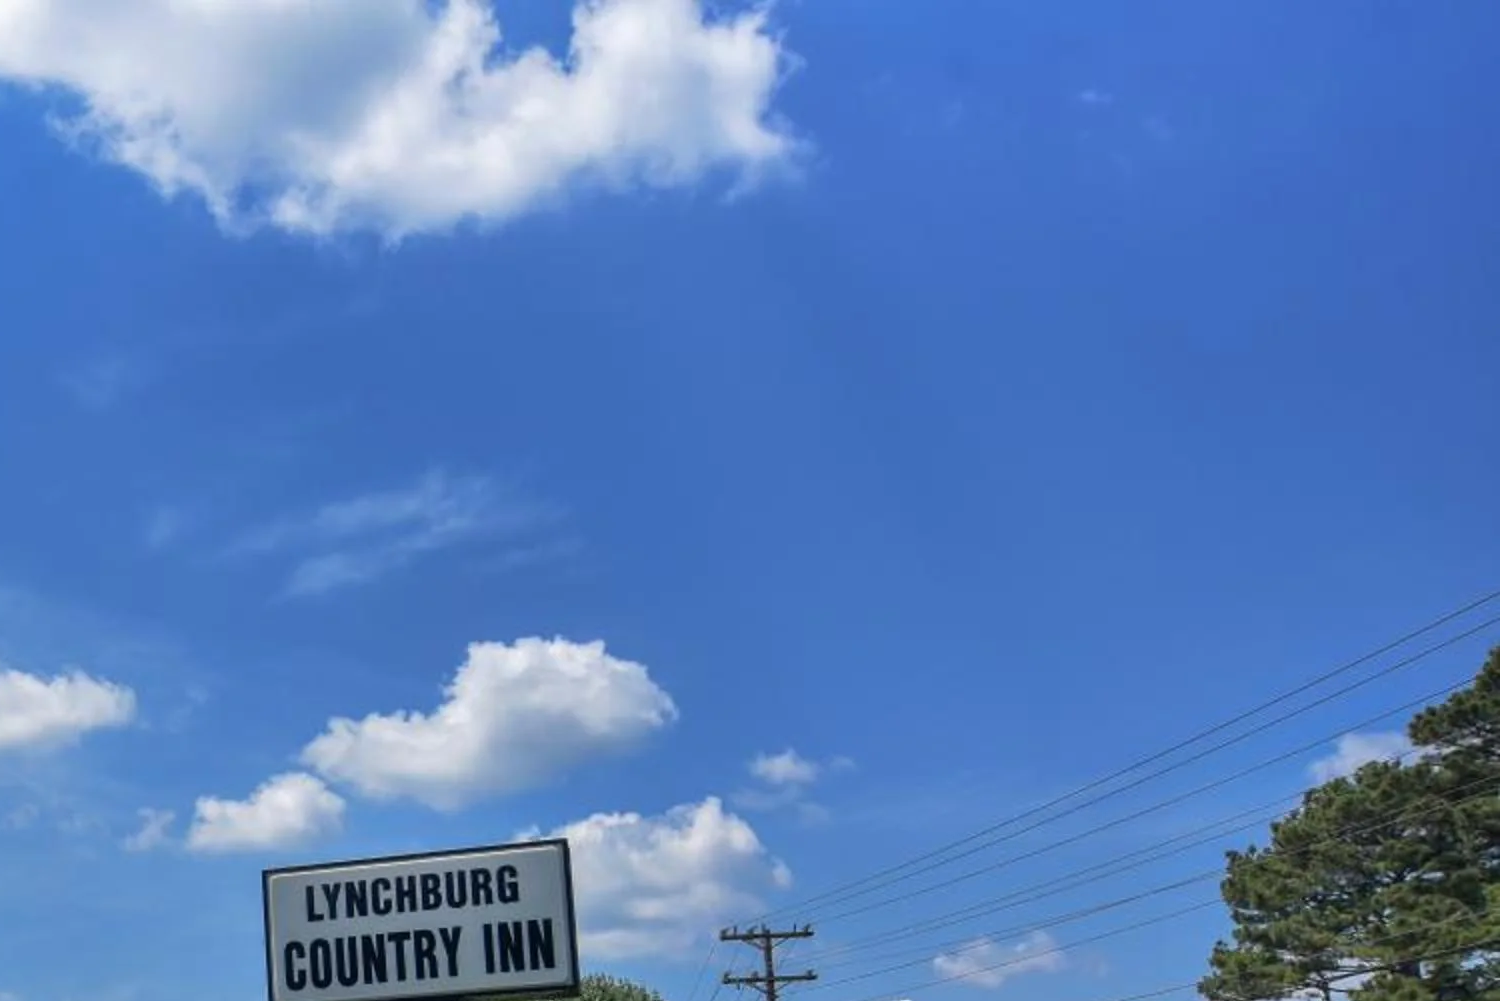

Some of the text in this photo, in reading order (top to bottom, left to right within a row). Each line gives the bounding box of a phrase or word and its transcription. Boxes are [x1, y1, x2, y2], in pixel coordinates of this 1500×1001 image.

[304, 864, 520, 922] LYNCHBURG
[284, 917, 556, 992] COUNTRY INN
